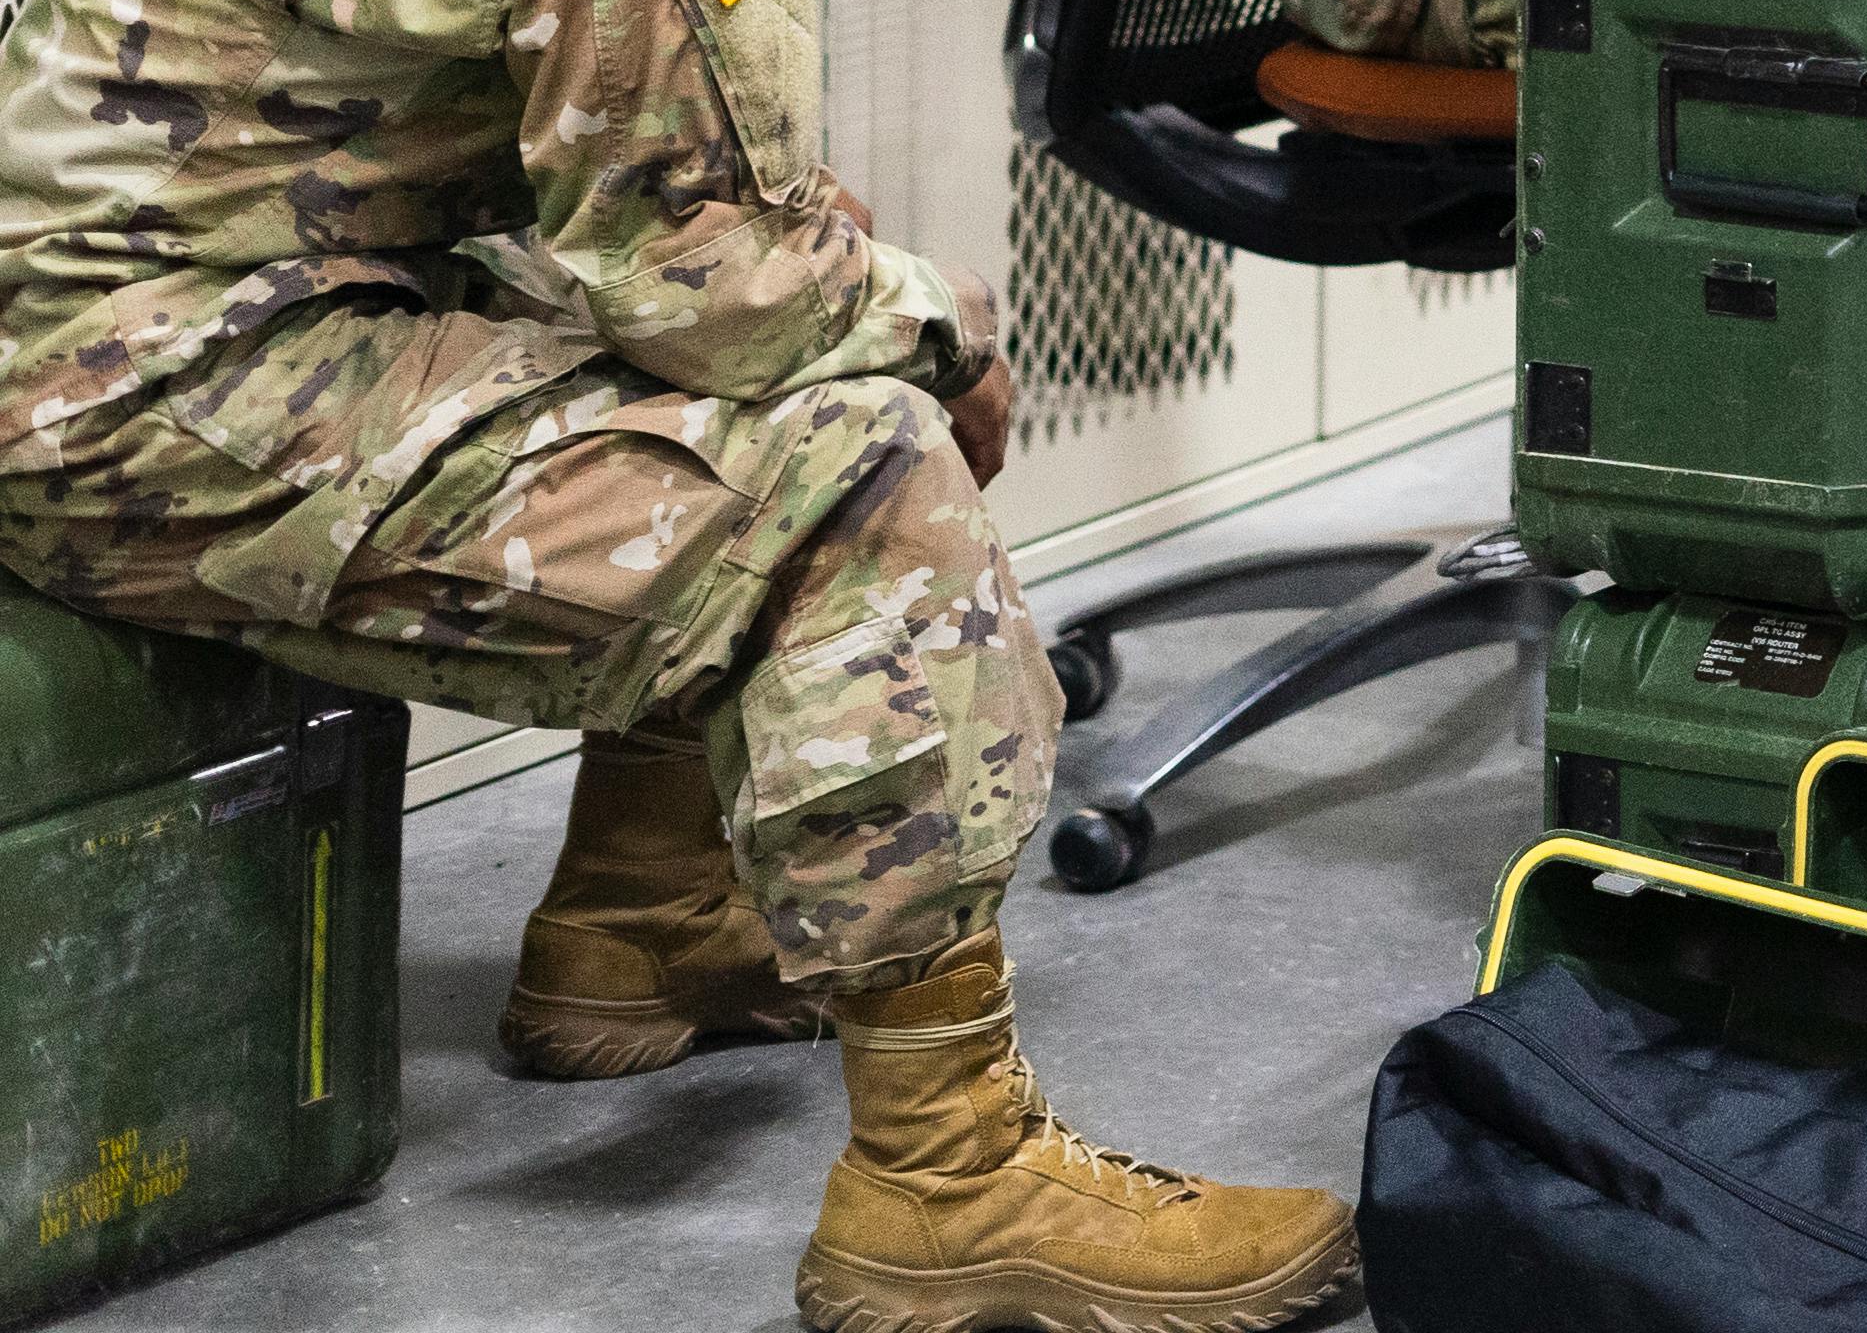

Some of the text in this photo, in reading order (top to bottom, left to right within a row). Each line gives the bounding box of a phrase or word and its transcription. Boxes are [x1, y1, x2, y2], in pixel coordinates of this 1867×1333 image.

[1786, 620, 1808, 630] ITEM
[1784, 630, 1807, 639] ASSY
[1767, 638, 1800, 649] ROUTER
